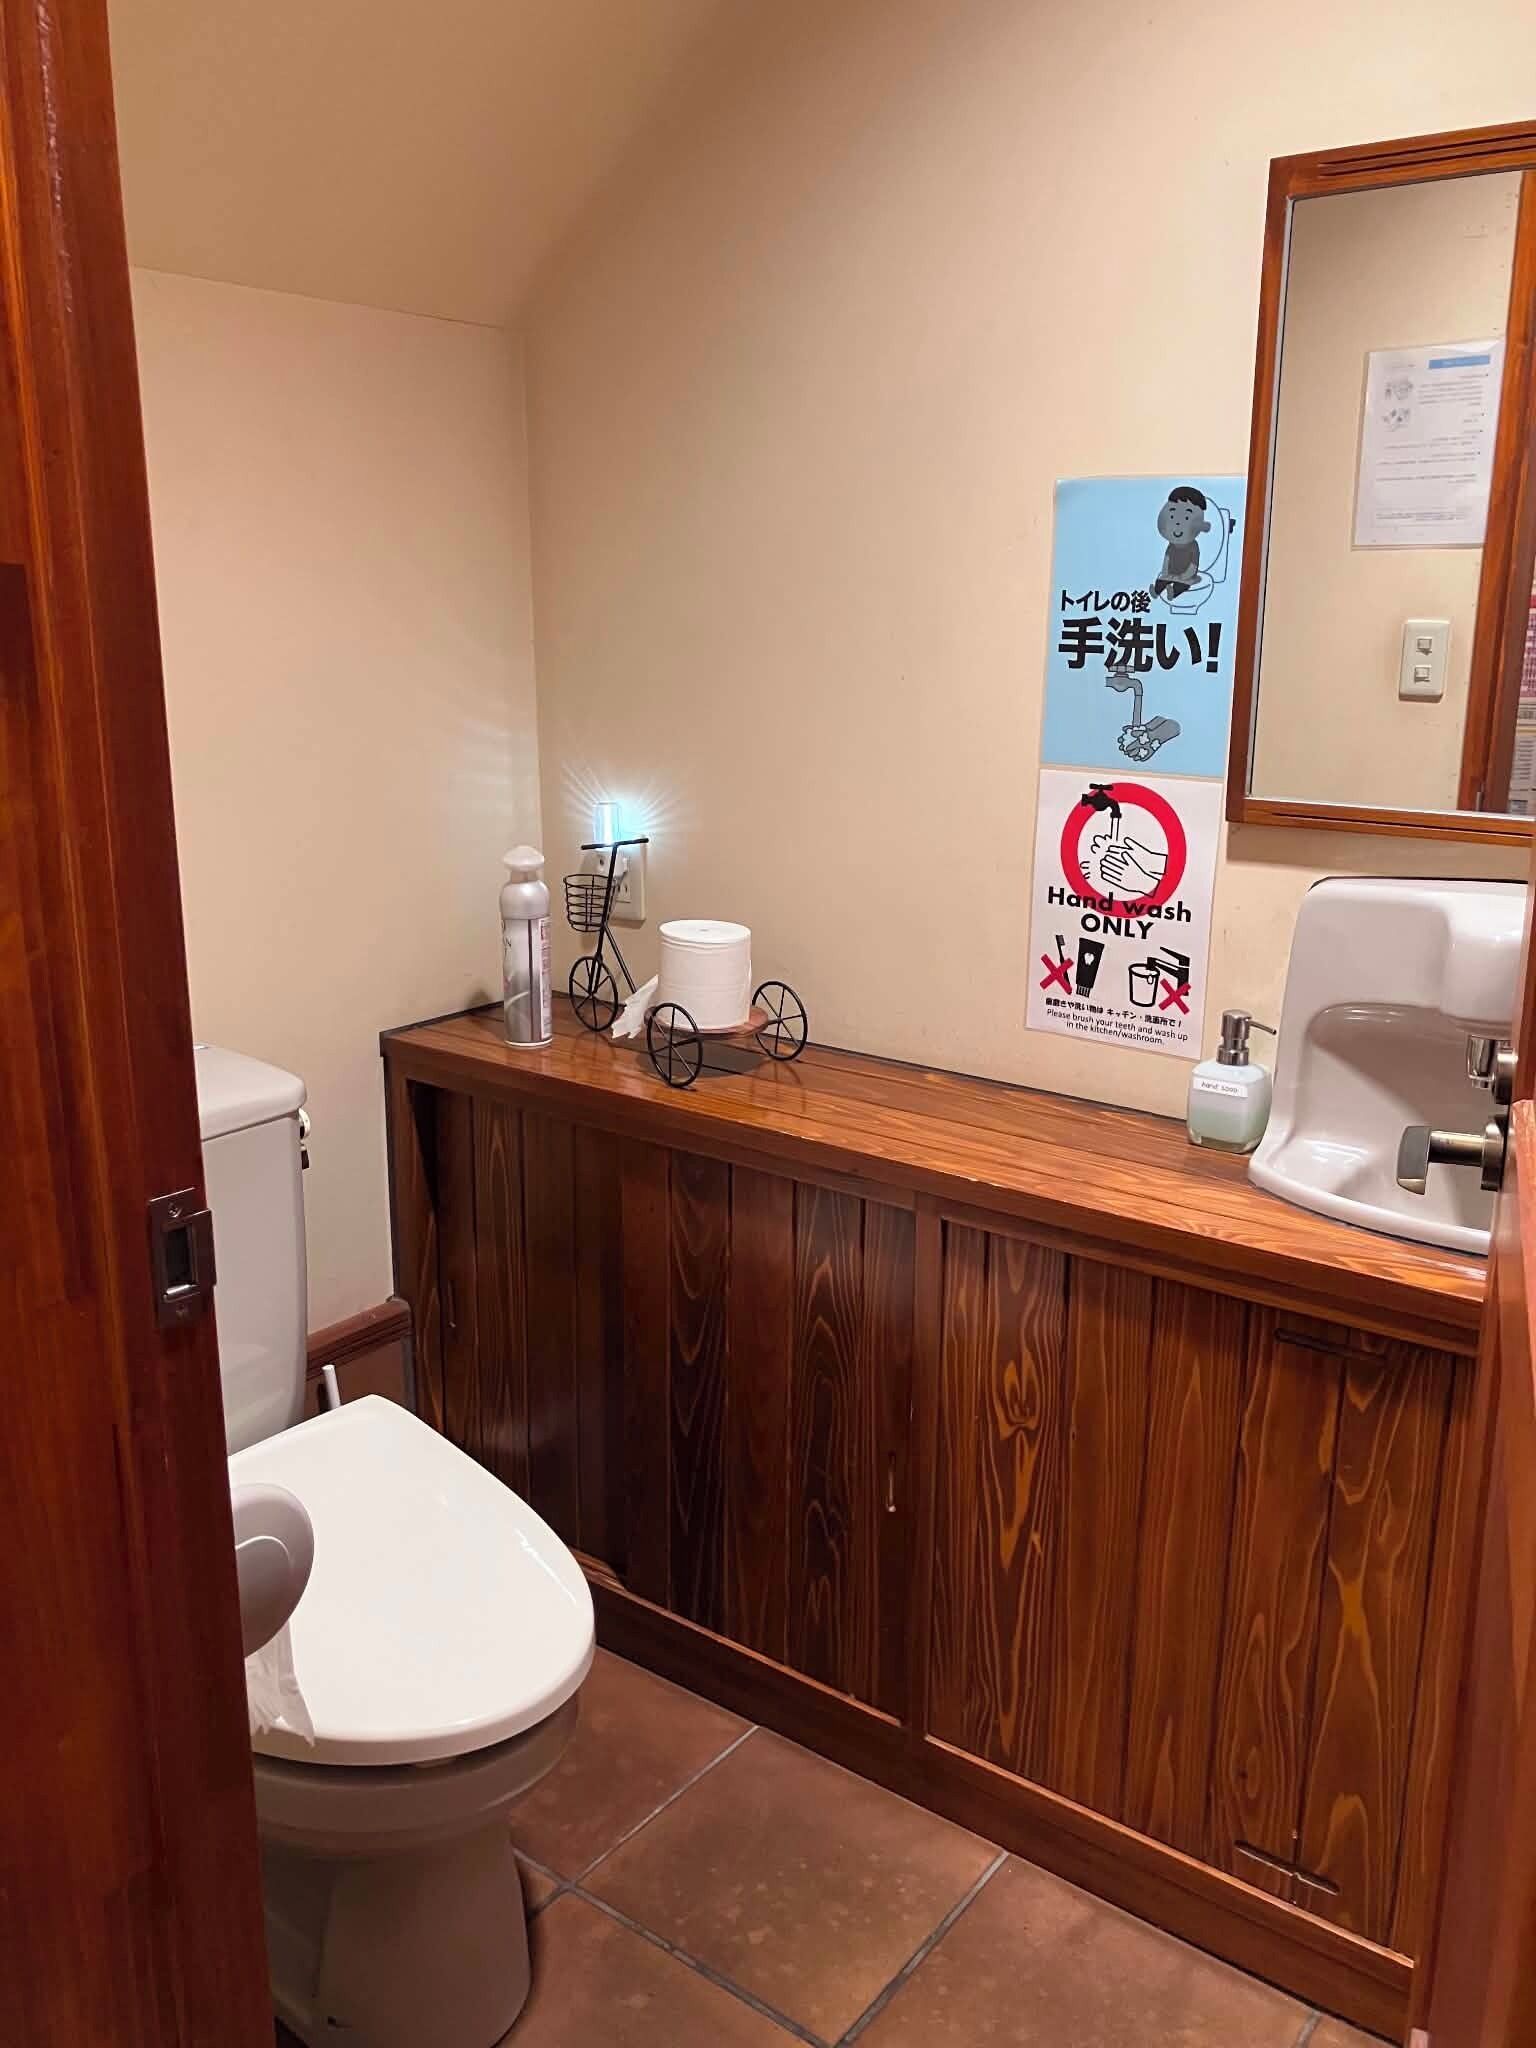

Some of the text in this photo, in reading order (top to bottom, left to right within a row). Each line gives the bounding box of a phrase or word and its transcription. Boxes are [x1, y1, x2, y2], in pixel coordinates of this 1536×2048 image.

[1060, 589, 1151, 613] トイレの後
[1047, 886, 1192, 922] Hand wash
[1081, 913, 1154, 939] ONLY
[1047, 1008, 1188, 1042] Please brush your teeth and wash up
[1066, 1021, 1074, 1029] in
[1076, 1022, 1088, 1031] the
